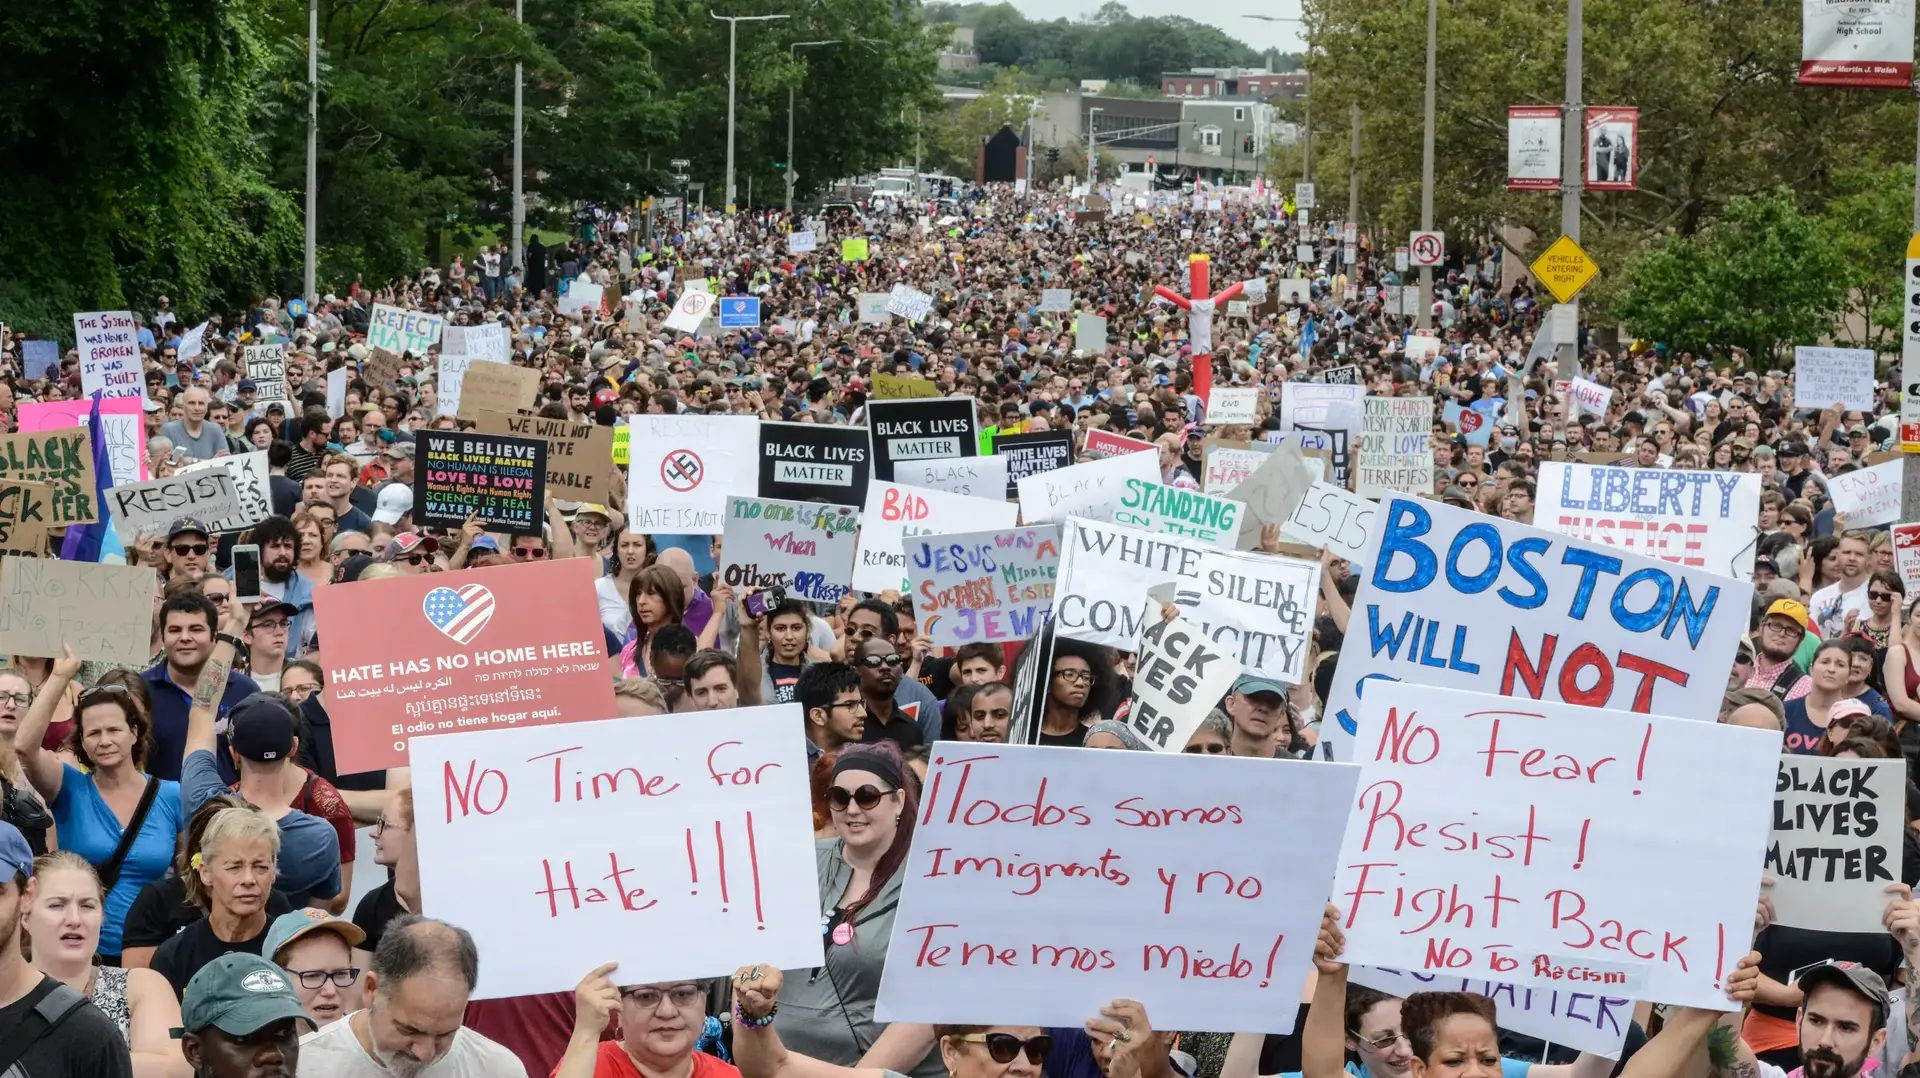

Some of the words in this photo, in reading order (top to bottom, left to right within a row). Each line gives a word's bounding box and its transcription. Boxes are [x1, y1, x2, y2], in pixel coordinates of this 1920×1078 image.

[1837, 27, 1853, 36] High
[1856, 27, 1882, 35] School
[1812, 65, 1836, 74] Mayor
[1874, 66, 1898, 74] Walsh
[1547, 255, 1584, 263] VEHICLES
[1546, 265, 1584, 273] ENTERING
[1553, 275, 1576, 283] RIGHT
[78, 318, 97, 329] THE
[374, 308, 441, 341] REJECT
[84, 334, 102, 344] WAS
[104, 332, 131, 343] NEVER
[91, 346, 134, 360] BROKEN
[247, 348, 282, 361] BLACK
[85, 363, 96, 373] IT
[102, 360, 123, 371] WAS
[248, 362, 284, 379] LIVES
[1327, 368, 1353, 379] BLACK
[102, 371, 138, 386] BUILT
[258, 383, 286, 397] ATTER
[1575, 384, 1604, 408] LOVE
[1364, 399, 1389, 416] YOUR
[1393, 399, 1429, 416] HATRED
[1464, 413, 1477, 423] NO
[508, 418, 529, 433] WE
[536, 420, 567, 438] WILL
[570, 425, 593, 440] NOT
[877, 421, 923, 436] BLACK
[930, 419, 969, 433] LIVES
[428, 438, 455, 453] WE
[463, 440, 536, 460] BELIEVE
[765, 442, 815, 459] BLACK
[824, 446, 865, 462] LIVES
[896, 441, 953, 456] MATTER
[1001, 447, 1035, 461] WHITE
[1036, 445, 1067, 458] LIVES
[1096, 441, 1117, 453] HATE
[1361, 435, 1385, 453] OUR
[1394, 434, 1429, 454] LOVE
[427, 460, 445, 470] NO
[447, 461, 486, 474] HUMAN
[489, 465, 498, 475] IS
[500, 466, 533, 478] ILLEGAL
[428, 452, 460, 461] BLACK
[463, 454, 491, 464] LIVES
[495, 457, 534, 468] MATTER
[1010, 458, 1058, 472] MATTER
[427, 470, 467, 484] LOVE
[473, 474, 488, 486] IS
[494, 476, 533, 490] LOVE
[783, 465, 844, 482] MATTER
[925, 466, 978, 484] BLACK
[1361, 468, 1428, 485] TERRIFIES
[1840, 471, 1878, 492] END
[116, 474, 230, 518] RESIST
[426, 482, 455, 492] Women's
[456, 485, 475, 495] Rights
[476, 486, 488, 495] Are
[489, 488, 511, 497] Human
[513, 490, 532, 500] Rights
[1047, 475, 1107, 507] BLACK
[1558, 465, 1741, 518] LIBERTY
[1856, 482, 1899, 502] WHITE
[426, 491, 479, 505] SCIENCE
[486, 497, 496, 507] IS
[502, 498, 532, 510] REAL
[881, 488, 929, 521] BAD
[1120, 478, 1236, 531] STANDING
[426, 502, 474, 514] WATER
[481, 507, 495, 516] IS
[502, 509, 532, 520] LIFE
[635, 506, 671, 527] HATE
[677, 508, 693, 527] IS
[693, 509, 718, 527] NOT
[763, 503, 794, 522] one
[797, 504, 812, 526] is
[1287, 485, 1375, 549] ESIS
[1115, 511, 1150, 526] ON
[1164, 521, 1218, 542] THE
[913, 542, 997, 574] JESUS
[1036, 540, 1058, 560] A
[1078, 526, 1202, 578] WHITE
[1371, 499, 1720, 650] BOSTON
[1208, 569, 1307, 636] SILENCE
[953, 606, 1036, 640] JEW
[1142, 620, 1221, 680] ACK
[1366, 604, 1481, 675] WILL
[1500, 626, 1690, 714] NOT
[331, 664, 384, 684] HATE
[389, 656, 431, 676] HAS
[436, 652, 470, 670] NO
[474, 647, 537, 666] HOME
[542, 641, 601, 659] HERE.
[556, 664, 569, 674] לא
[572, 662, 600, 672] שנאה
[475, 673, 490, 682] פה
[492, 669, 522, 680] לחיות
[525, 667, 553, 677] יכולה
[358, 686, 382, 698] بيت
[383, 683, 394, 693] له
[396, 680, 423, 694] ليس
[425, 676, 452, 690] الكره
[336, 689, 356, 699] هنا
[391, 723, 403, 735] El
[407, 721, 434, 733] odio
[438, 720, 453, 729] no
[457, 715, 488, 727] tiene
[491, 711, 528, 724] hogar
[531, 706, 561, 720] aquí.
[526, 746, 681, 803] Time
[707, 740, 783, 787] for
[1775, 760, 1880, 800] BLACK
[1773, 801, 1879, 838] LIVES
[1764, 839, 1894, 882] MATTER
[1197, 870, 1262, 900] no
[1345, 863, 1520, 934] Fight
[906, 923, 1116, 973] Tenemos
[1532, 953, 1627, 986] Racism
